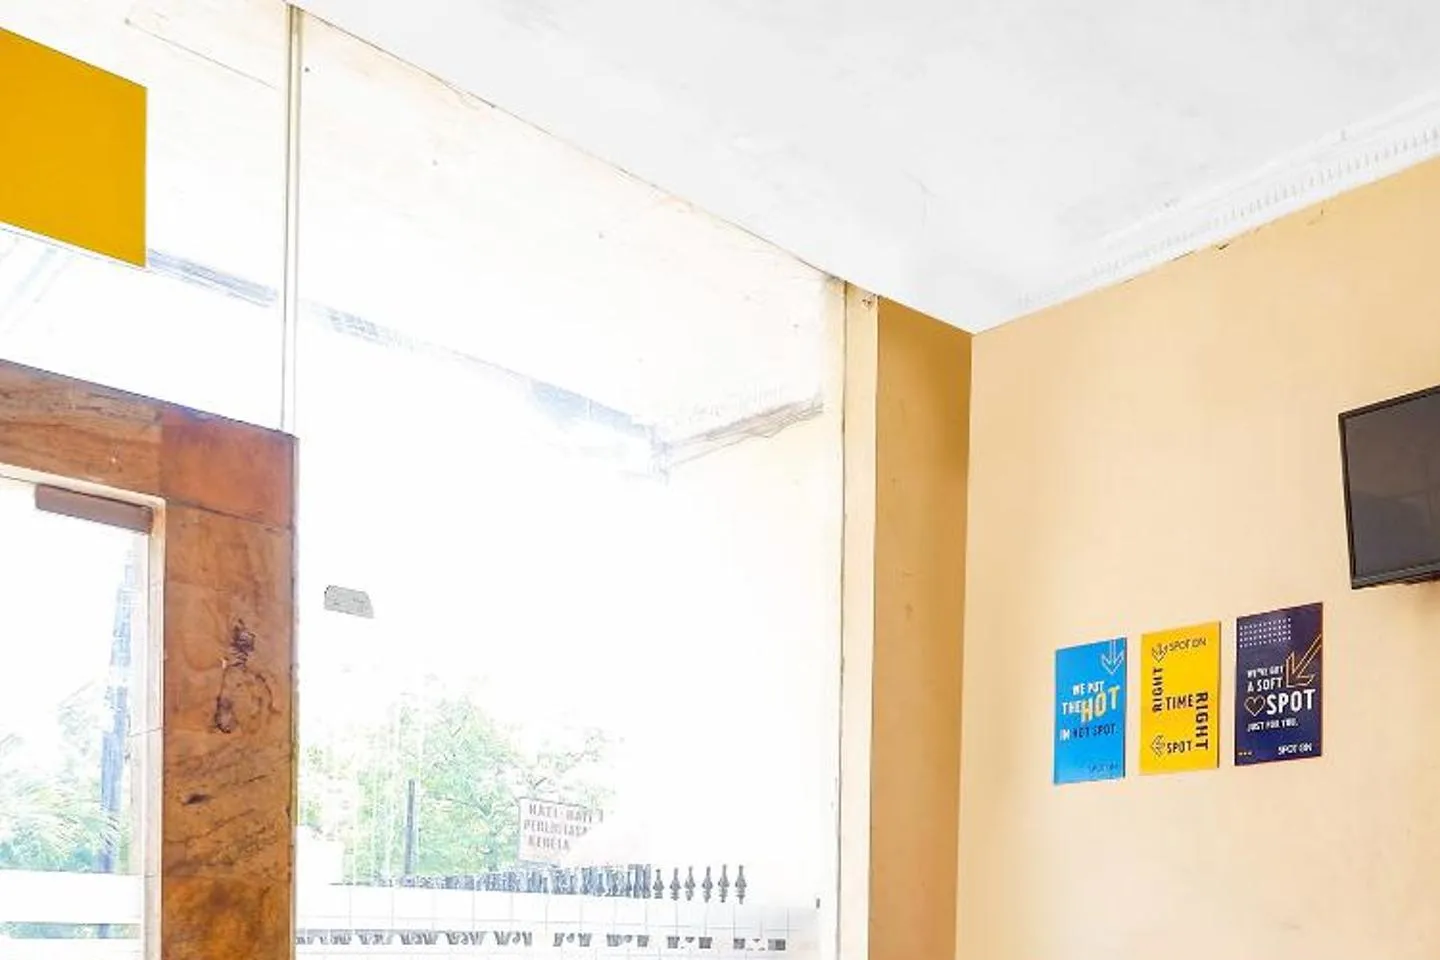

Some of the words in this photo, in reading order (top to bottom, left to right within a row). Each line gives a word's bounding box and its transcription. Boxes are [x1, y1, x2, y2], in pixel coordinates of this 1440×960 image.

[1169, 638, 1189, 652] SPOT
[1192, 637, 1206, 648] ON
[1072, 683, 1086, 696] WE
[1088, 681, 1105, 693] PUT
[1152, 667, 1164, 712] RIGHT
[1247, 681, 1254, 692] A
[1257, 677, 1282, 692] SOFT
[1062, 701, 1082, 715] THE
[1081, 685, 1120, 722] HOT
[1165, 694, 1193, 711] TIME
[1266, 689, 1315, 715] SPOT
[1195, 691, 1208, 750] RIGHT
[1247, 720, 1265, 732] JUST
[1266, 719, 1280, 729] FOR
[1166, 740, 1192, 754] SPOT
[1278, 744, 1297, 756] SPOT
